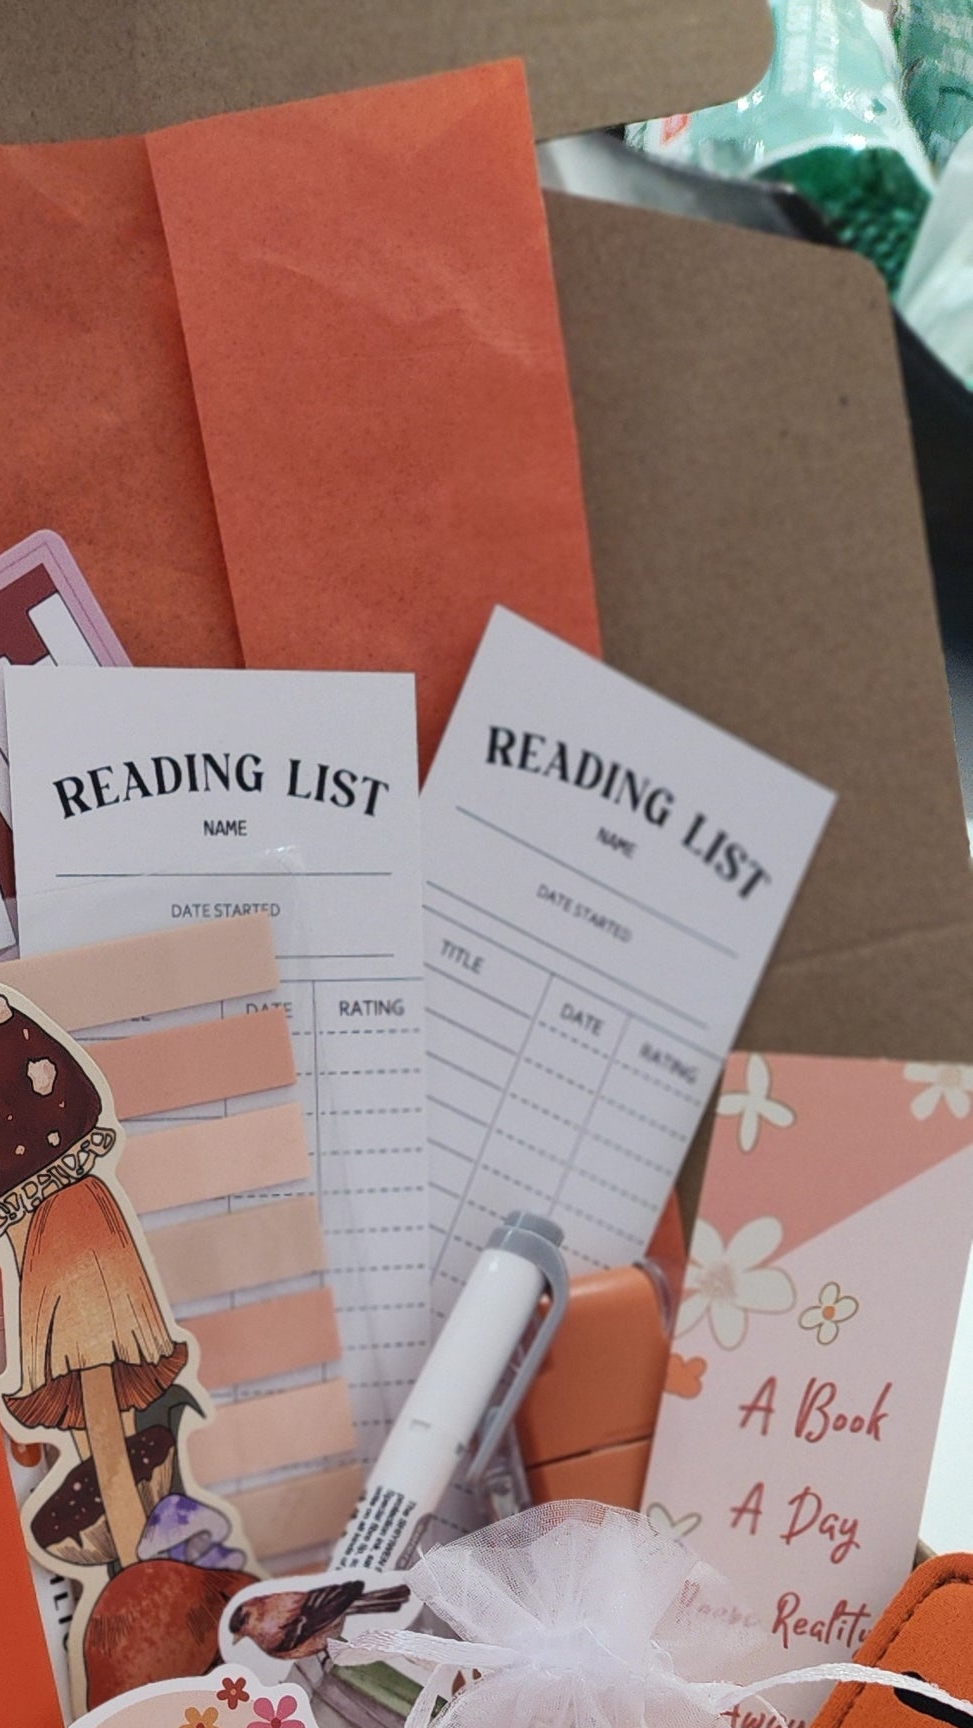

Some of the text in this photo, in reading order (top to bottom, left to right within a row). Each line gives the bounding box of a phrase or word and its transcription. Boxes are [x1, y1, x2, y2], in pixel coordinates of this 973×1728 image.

[53, 753, 390, 819] READING LIST
[485, 726, 772, 900] READING LIST
[203, 820, 247, 837] NAME
[596, 827, 638, 860] NAME
[171, 903, 281, 919] DATE STARTED
[537, 883, 633, 943] DATE STARTED
[440, 939, 485, 975] TITLE
[339, 999, 405, 1017] RATING
[560, 1003, 700, 1085] DATE RATING
[738, 1375, 893, 1444] A Book
[729, 1481, 861, 1565] A Day
